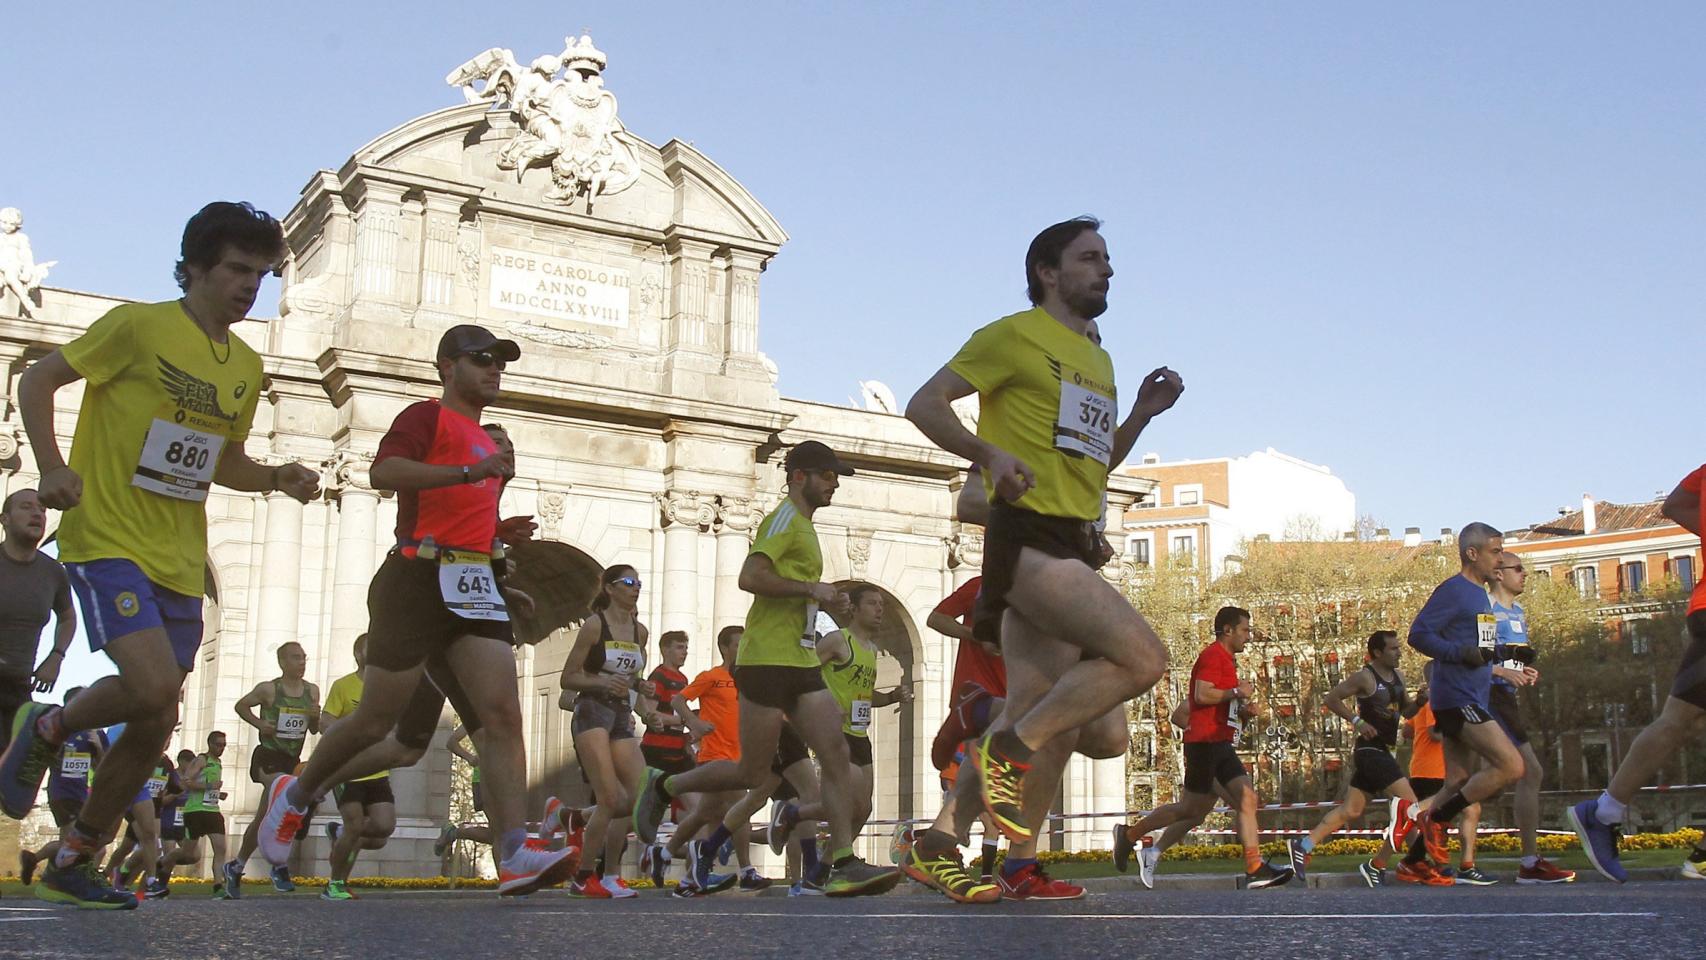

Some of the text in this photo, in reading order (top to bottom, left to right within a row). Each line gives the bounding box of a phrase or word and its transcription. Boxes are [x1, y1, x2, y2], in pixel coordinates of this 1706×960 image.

[491, 253, 630, 288] REGE CAROLO III
[536, 280, 587, 297] ANNO
[500, 291, 619, 320] MDCCLXXVIII
[1080, 402, 1109, 433] 376
[165, 441, 209, 470] 880
[457, 576, 491, 594] 643
[616, 657, 636, 669] 794
[285, 719, 304, 728] 609
